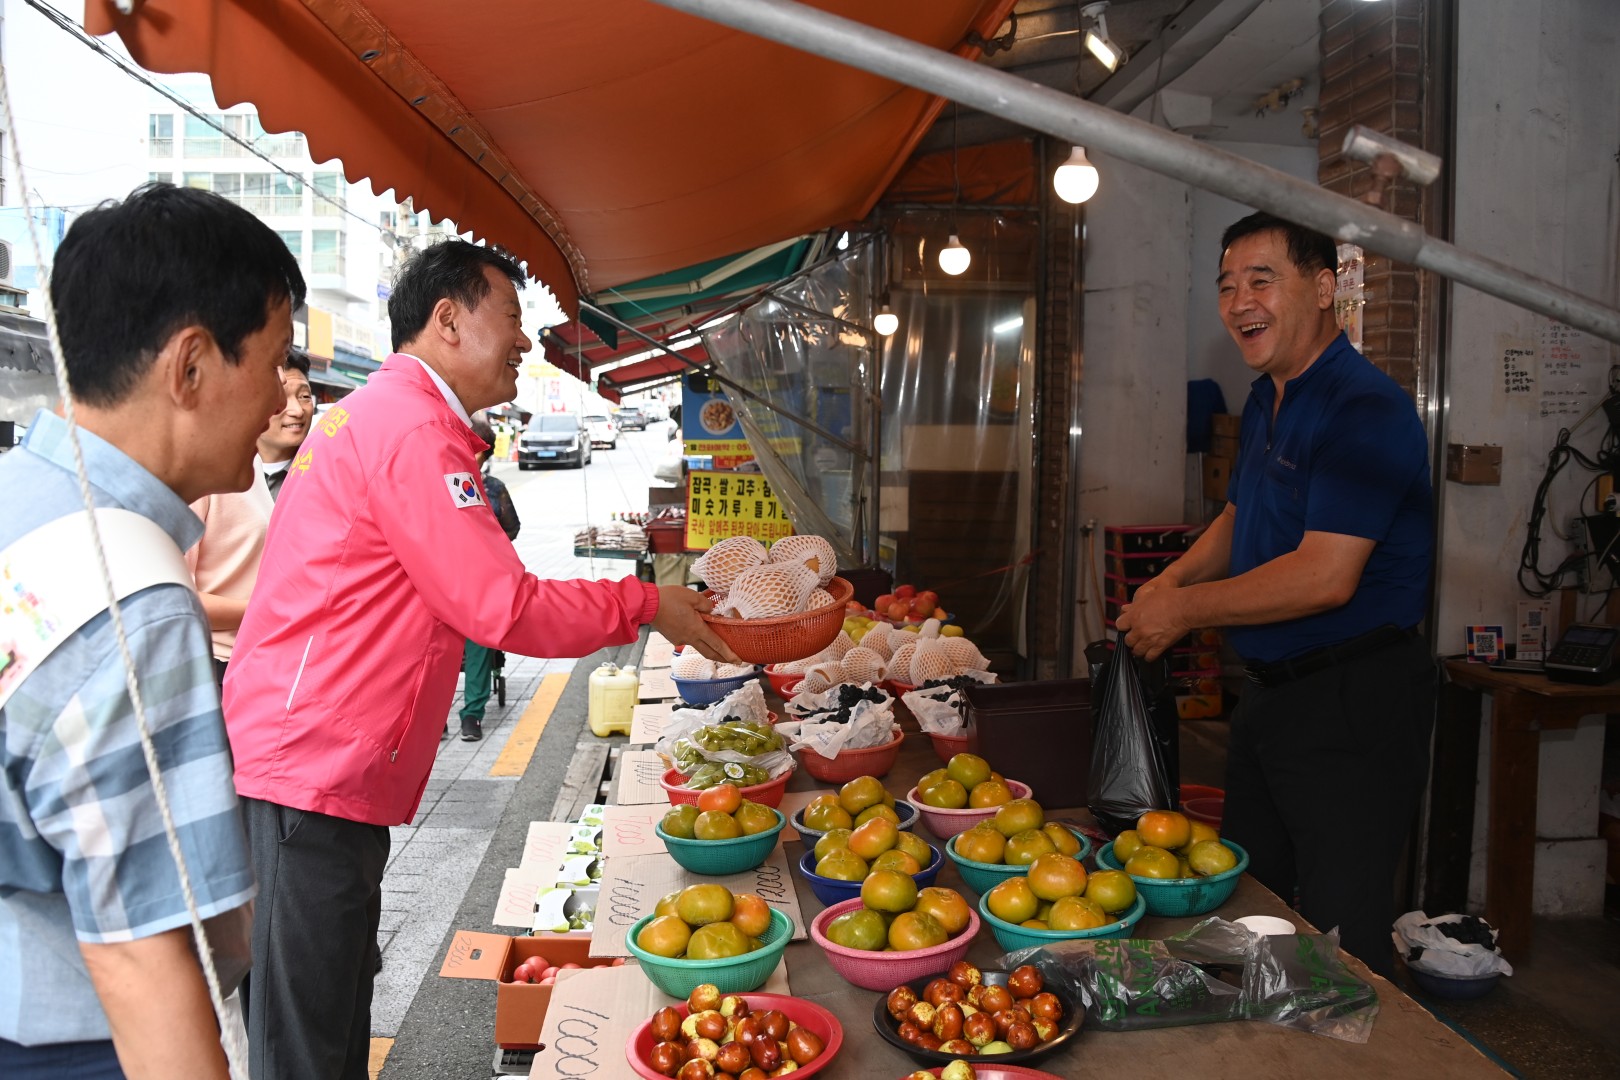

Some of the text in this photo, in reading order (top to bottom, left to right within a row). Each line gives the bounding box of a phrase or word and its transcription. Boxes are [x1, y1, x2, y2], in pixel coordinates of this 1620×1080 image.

[691, 518, 705, 535] 국산
[761, 522, 790, 539] 드립니다
[554, 1004, 610, 1080] 1000
